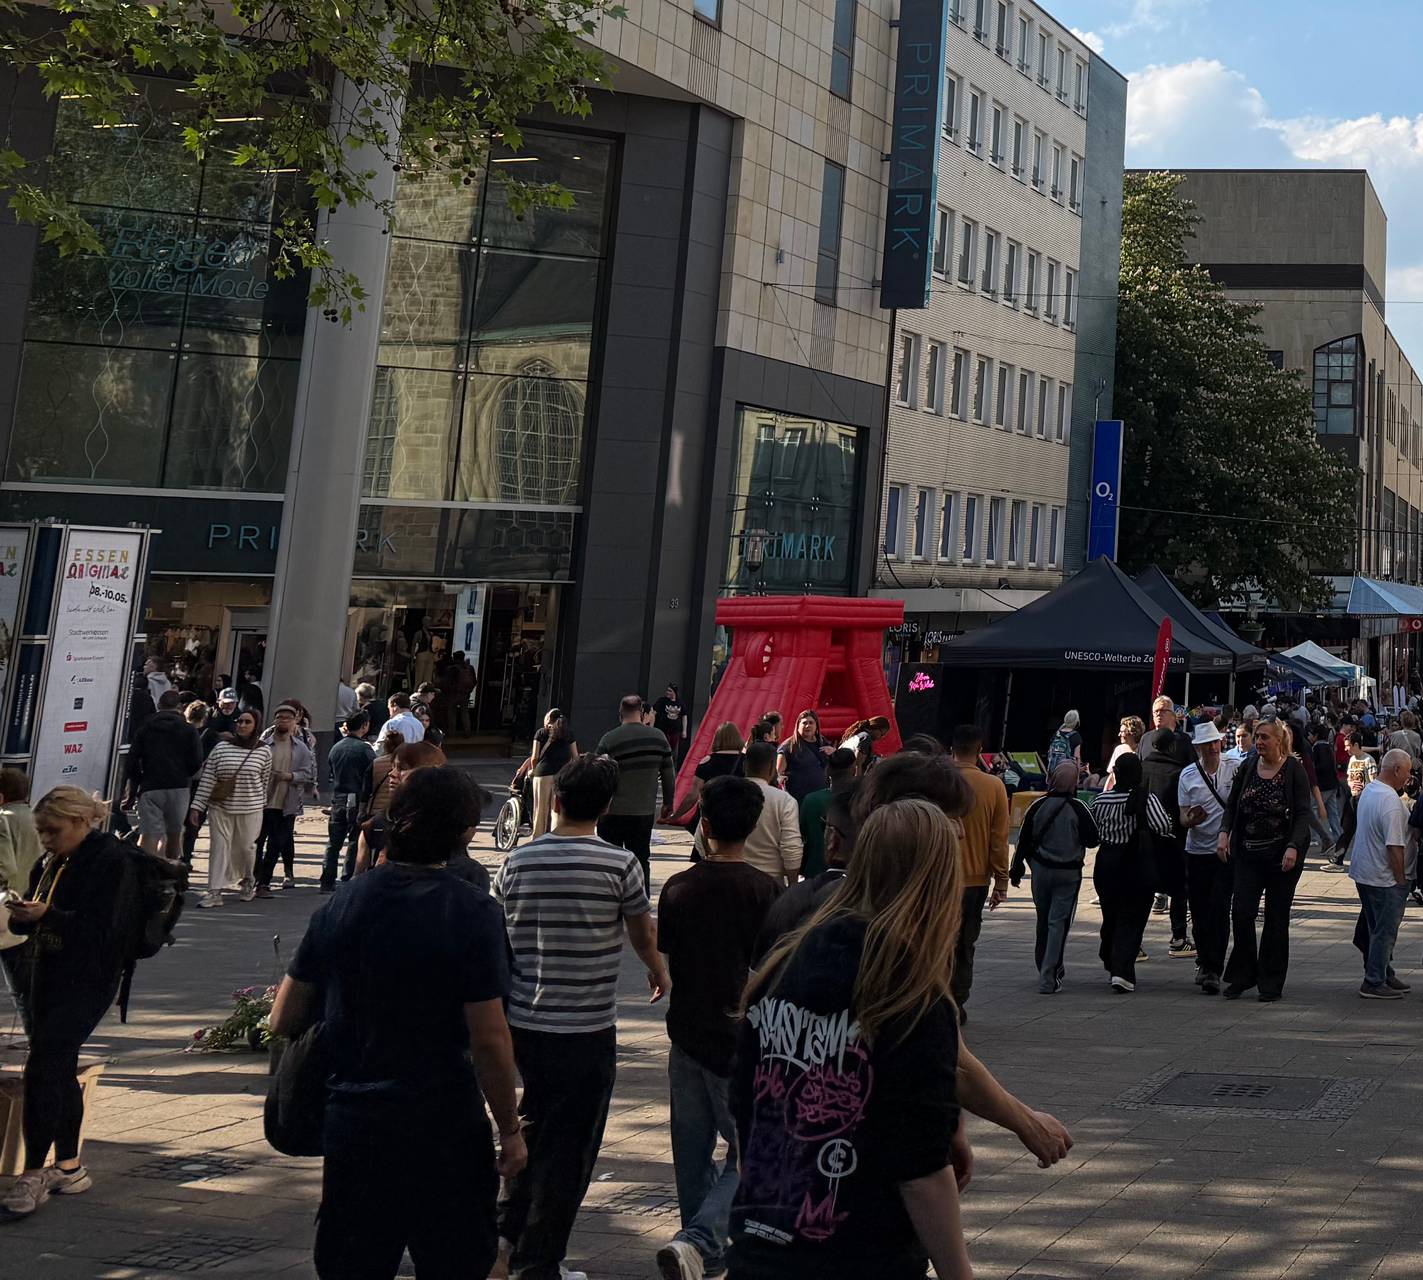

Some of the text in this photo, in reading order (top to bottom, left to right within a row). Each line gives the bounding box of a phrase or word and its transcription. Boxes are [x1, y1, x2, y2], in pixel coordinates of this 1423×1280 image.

[891, 43, 933, 251] PRIMARK
[191, 272, 270, 299] Mode
[208, 523, 400, 554] PRIRK
[73, 548, 129, 563] ESSEN
[66, 562, 130, 580] ORIGINAL
[671, 598, 679, 609] 39
[1064, 651, 1185, 665] UNESCO-Welterbe Zorein
[64, 743, 84, 755] WAZ
